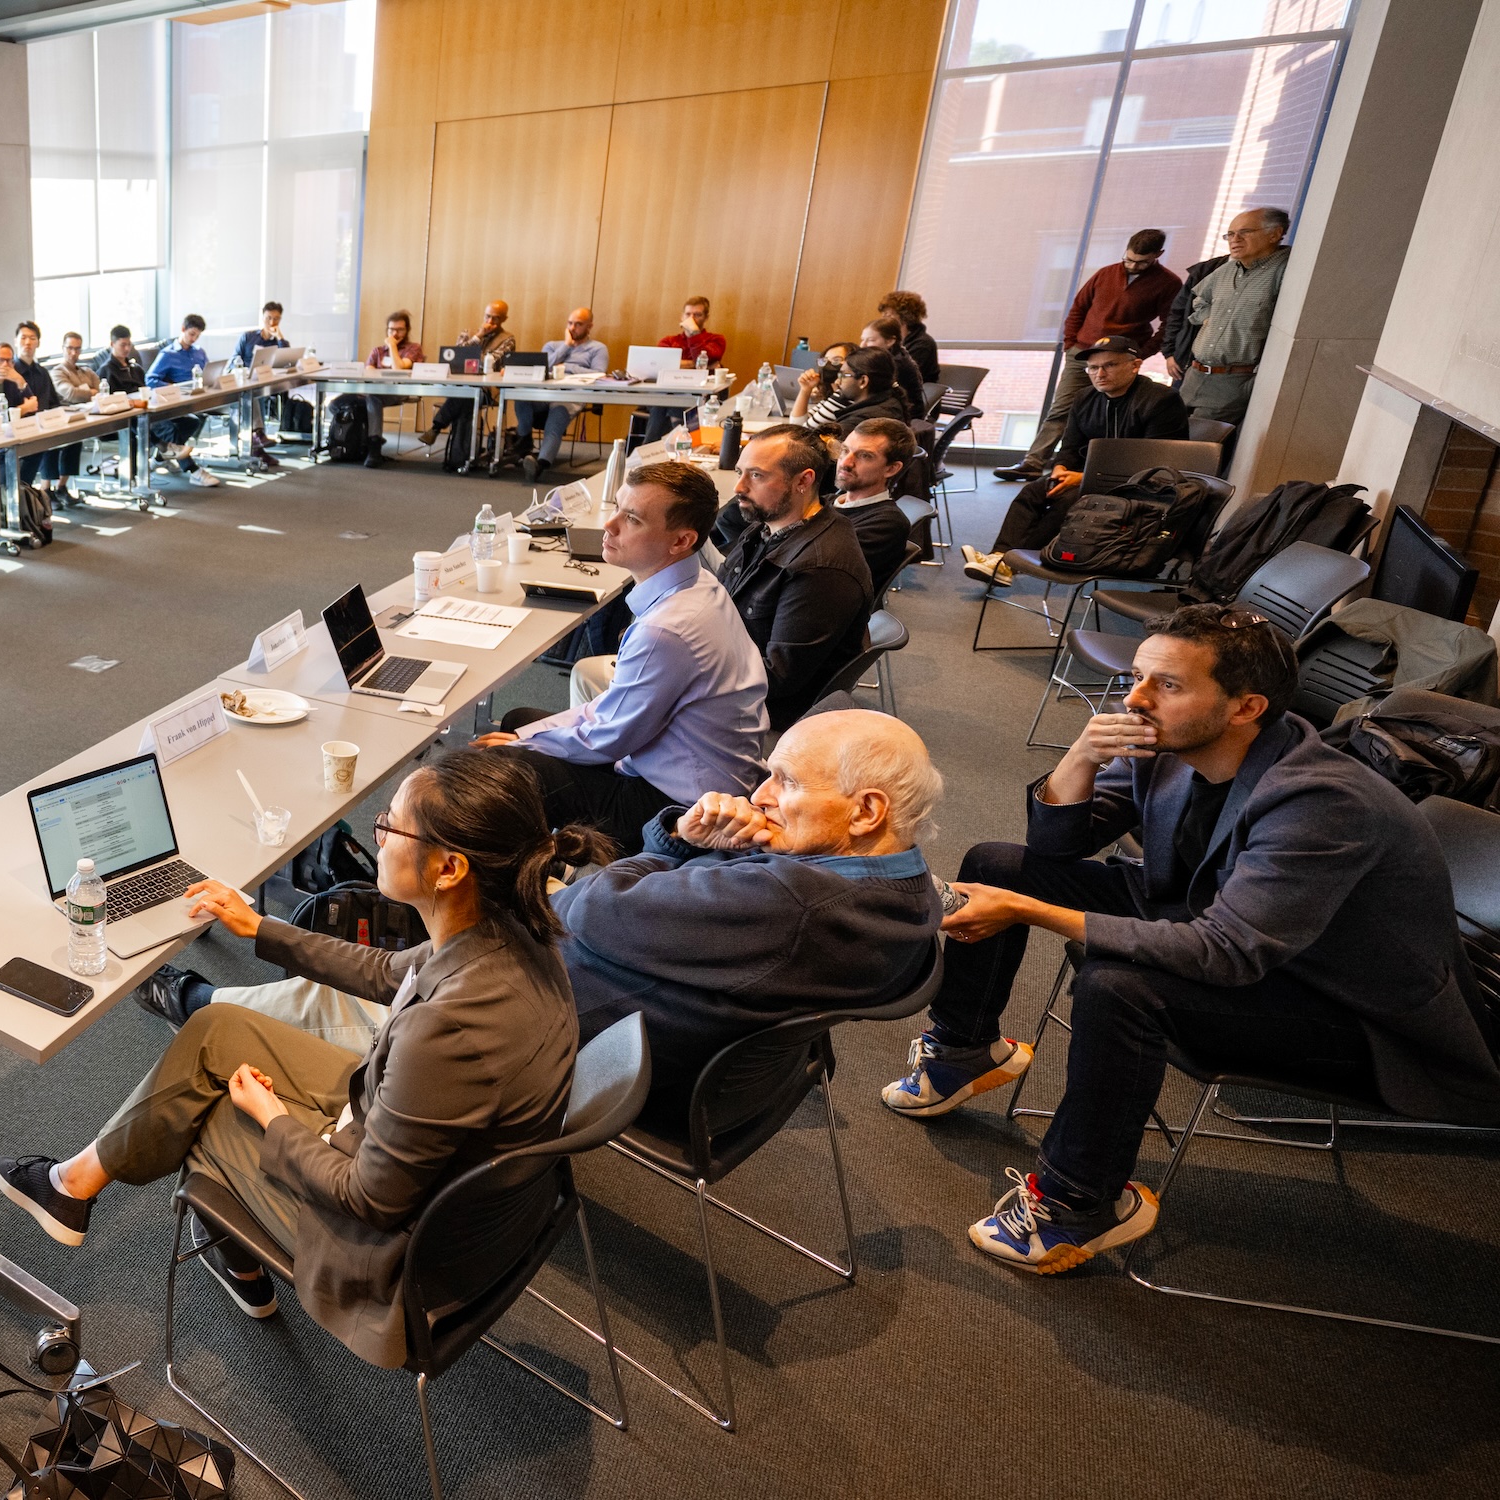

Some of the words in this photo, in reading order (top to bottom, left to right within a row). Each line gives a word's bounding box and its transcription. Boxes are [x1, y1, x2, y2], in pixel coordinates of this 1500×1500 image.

[167, 729, 186, 744] Frank
[186, 724, 197, 733] von
[196, 712, 216, 729] Hippel
